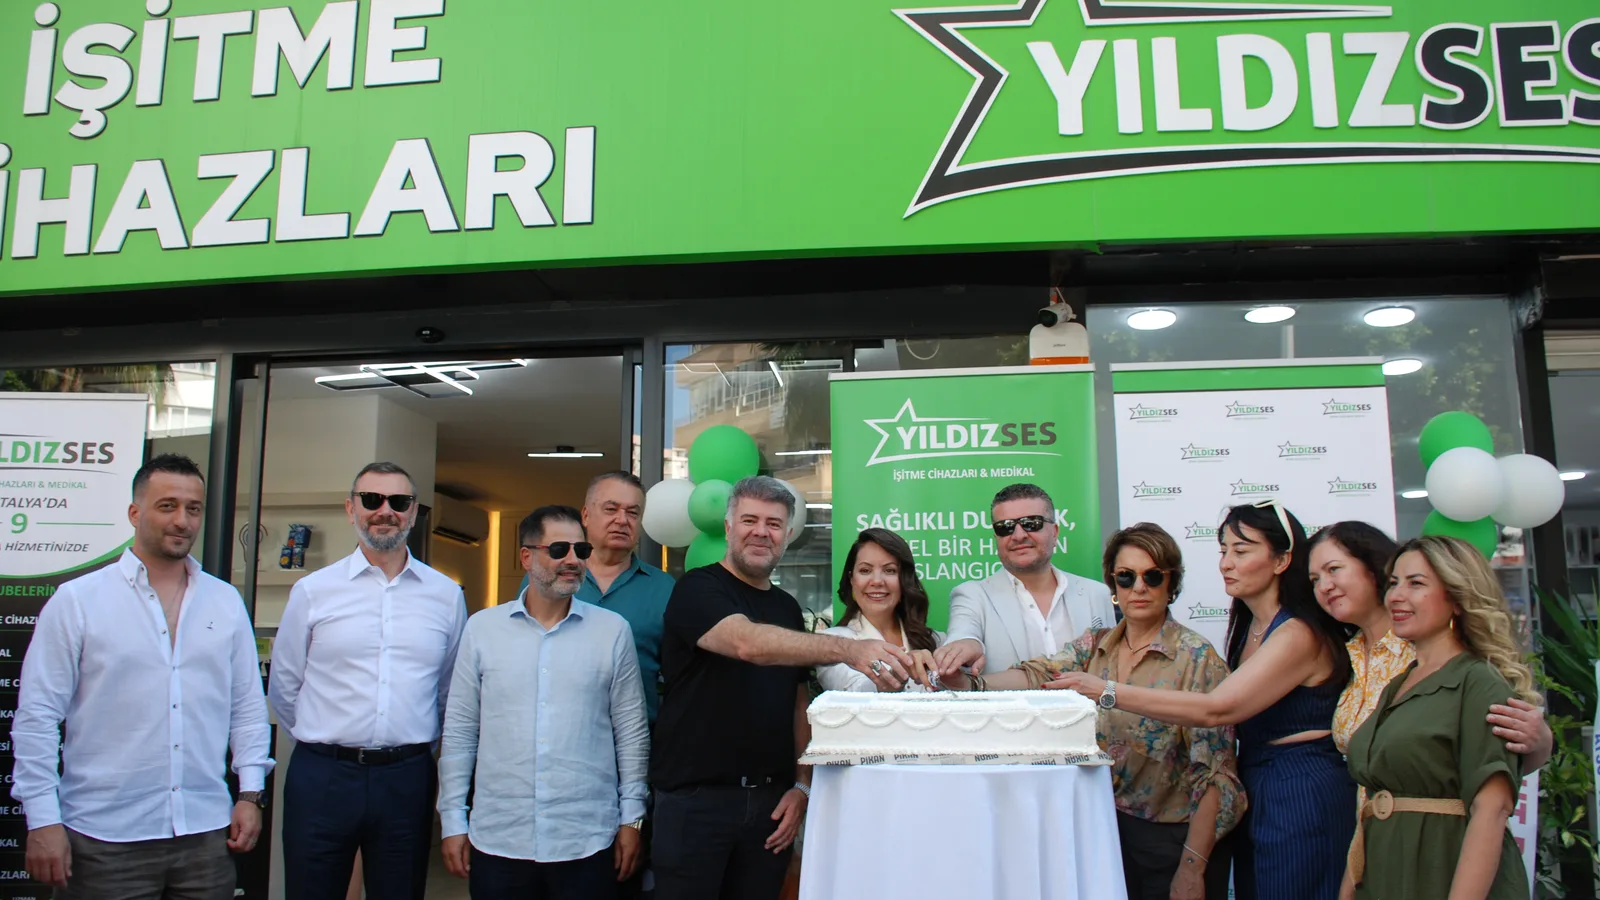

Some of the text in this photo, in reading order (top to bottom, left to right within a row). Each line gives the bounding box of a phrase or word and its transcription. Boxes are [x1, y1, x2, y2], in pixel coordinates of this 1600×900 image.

[22, 0, 446, 139] İŞİTME
[1233, 406, 1275, 414] YILDIZSES
[1330, 403, 1371, 411] YILDIZSES
[1136, 408, 1178, 417] YILDIZSES
[896, 422, 1057, 450] YILDIZSES
[1188, 448, 1230, 456] YILDIZSES
[1286, 446, 1327, 454] YILDIZSES
[893, 466, 1035, 482] İŞİTME CİHAZLARI & MEDİKAL
[38, 480, 45, 489] &
[47, 479, 88, 489] MEDİKAL
[1239, 484, 1280, 492] YILDIZSES
[1336, 482, 1377, 490] YILDIZSES
[1140, 486, 1182, 495] YILDIZSES
[11, 513, 28, 534] 9
[856, 508, 954, 533] SAĞLIKLI
[5, 541, 89, 553] HİZMETİNİZDE
[939, 535, 971, 557] BİR
[860, 755, 885, 765] PIKAN
